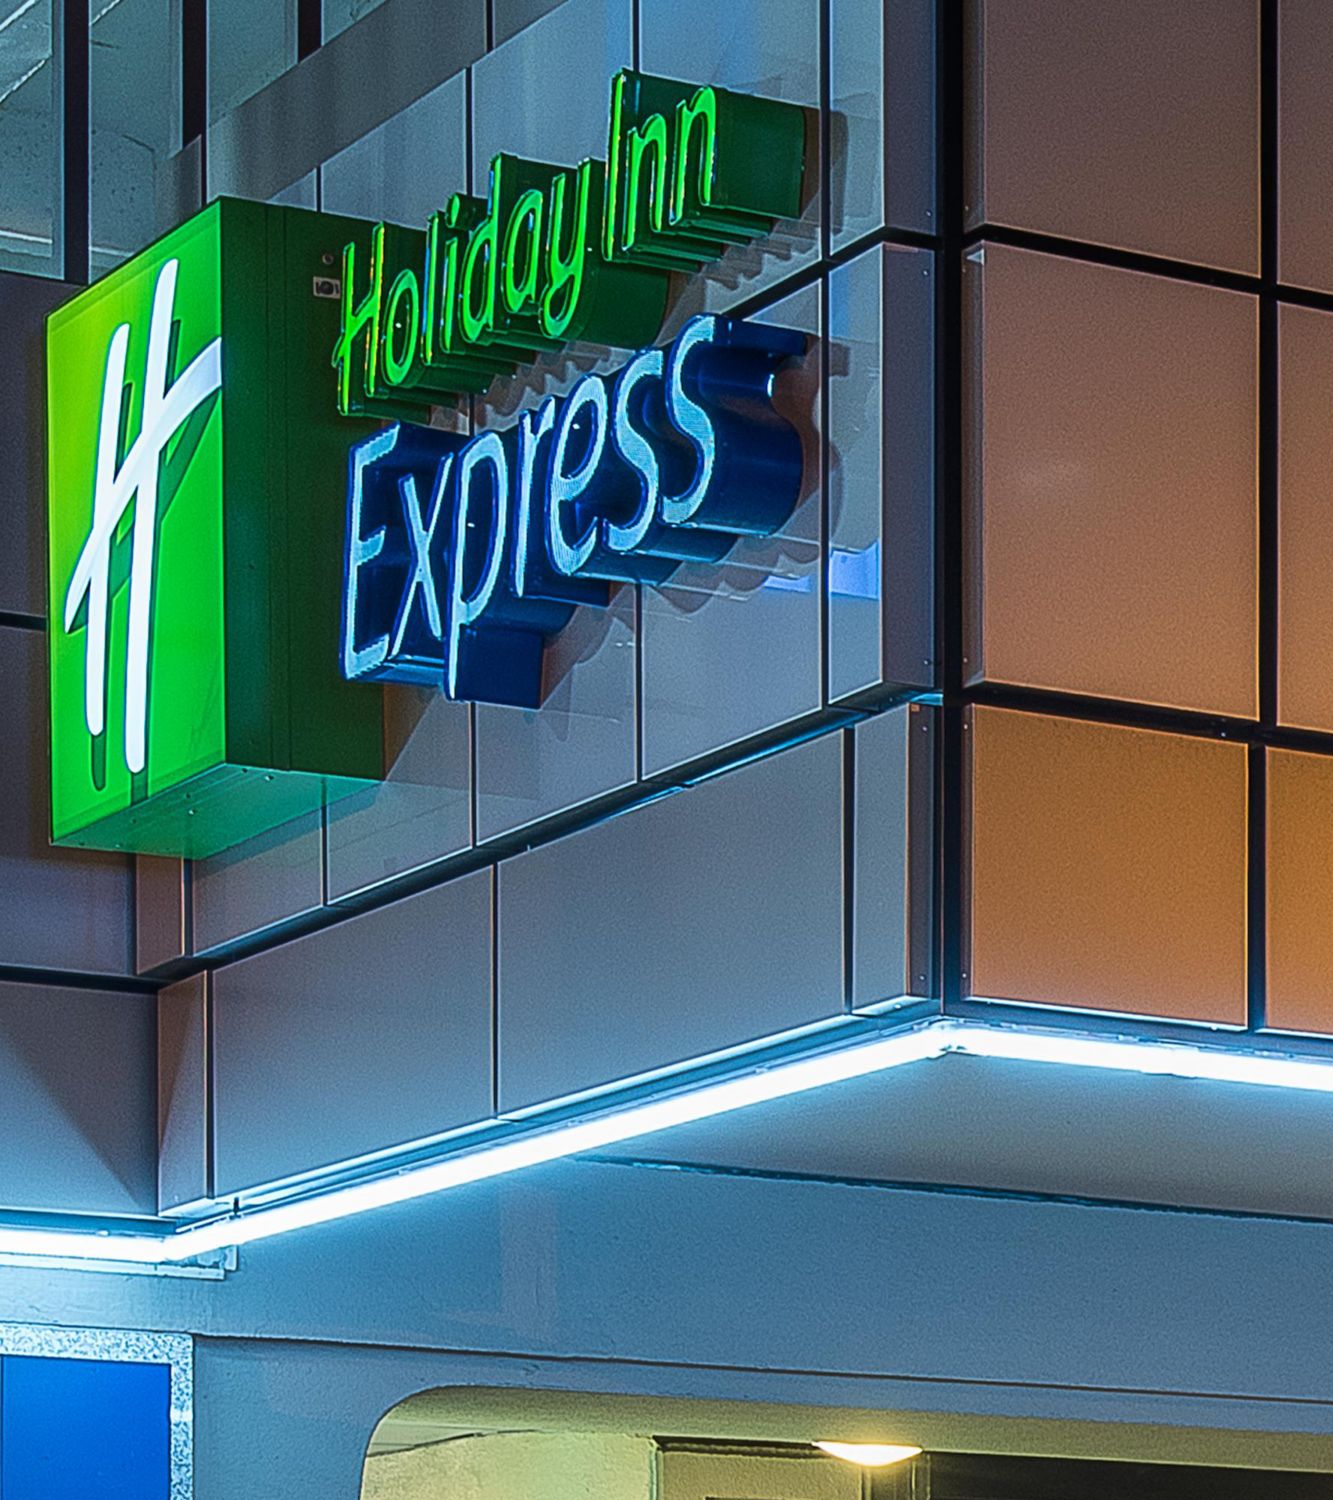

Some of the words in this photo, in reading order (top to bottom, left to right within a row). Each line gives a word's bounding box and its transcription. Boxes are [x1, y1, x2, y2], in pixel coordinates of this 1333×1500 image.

[332, 152, 592, 416] Holiday
[602, 68, 717, 261] Inn
[342, 314, 716, 701] Express
